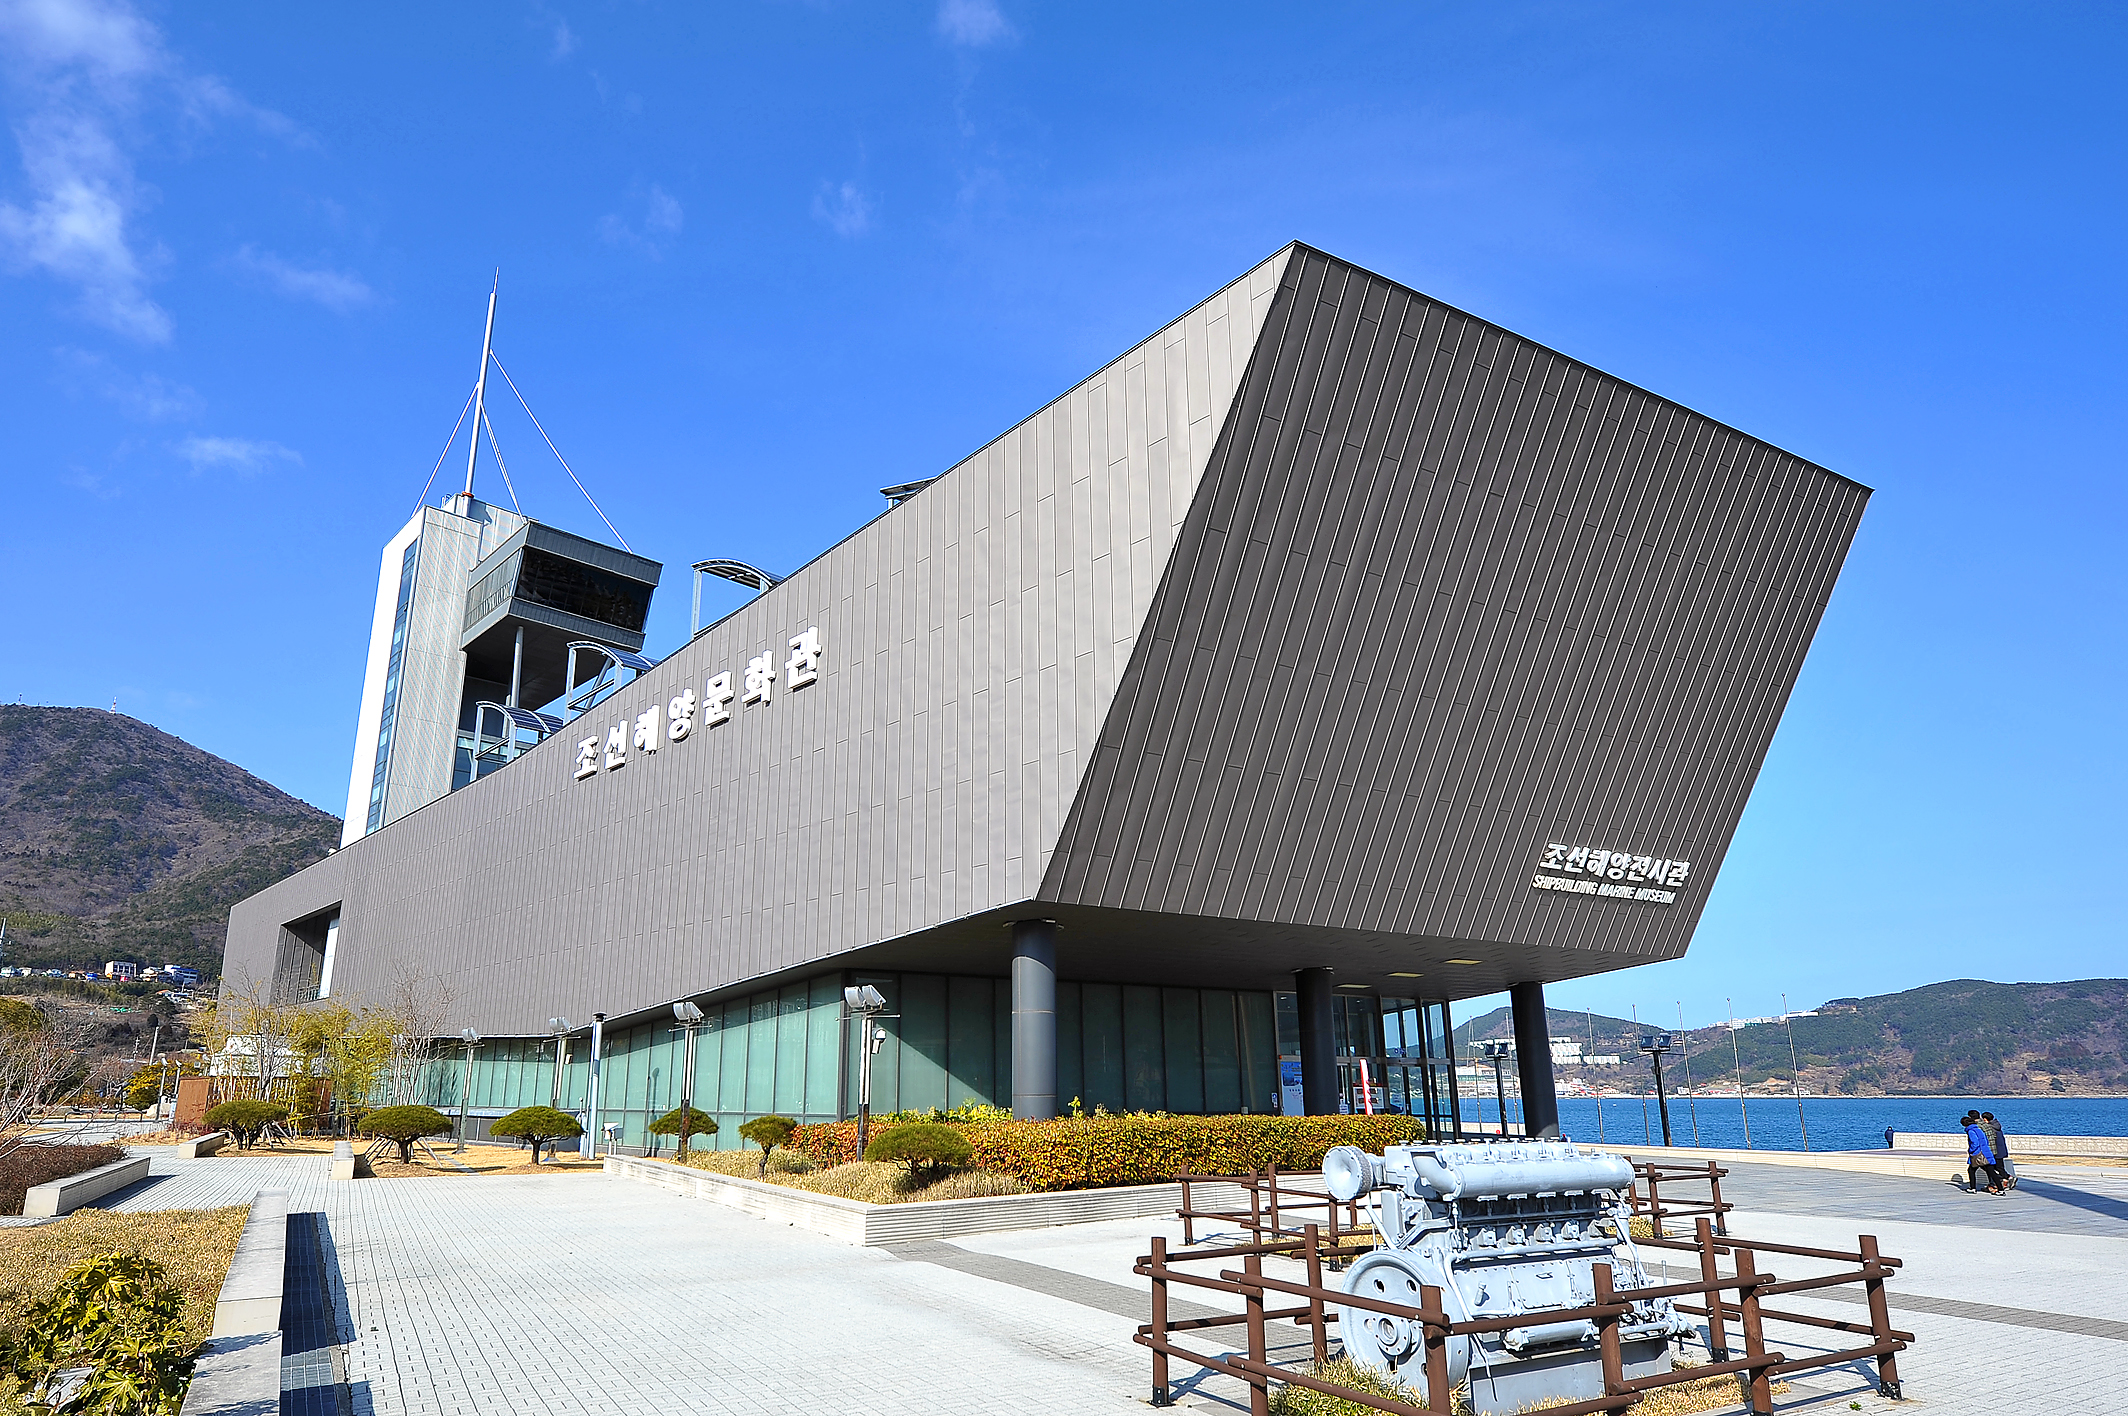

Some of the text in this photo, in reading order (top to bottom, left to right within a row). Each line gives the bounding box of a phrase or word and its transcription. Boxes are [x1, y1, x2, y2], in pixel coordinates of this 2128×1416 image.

[573, 625, 822, 780] 조선해양문화관
[1540, 843, 1691, 887] 조선해양전시관
[1532, 874, 1677, 905] SHIPBUILDING MARINE MUSEUM
